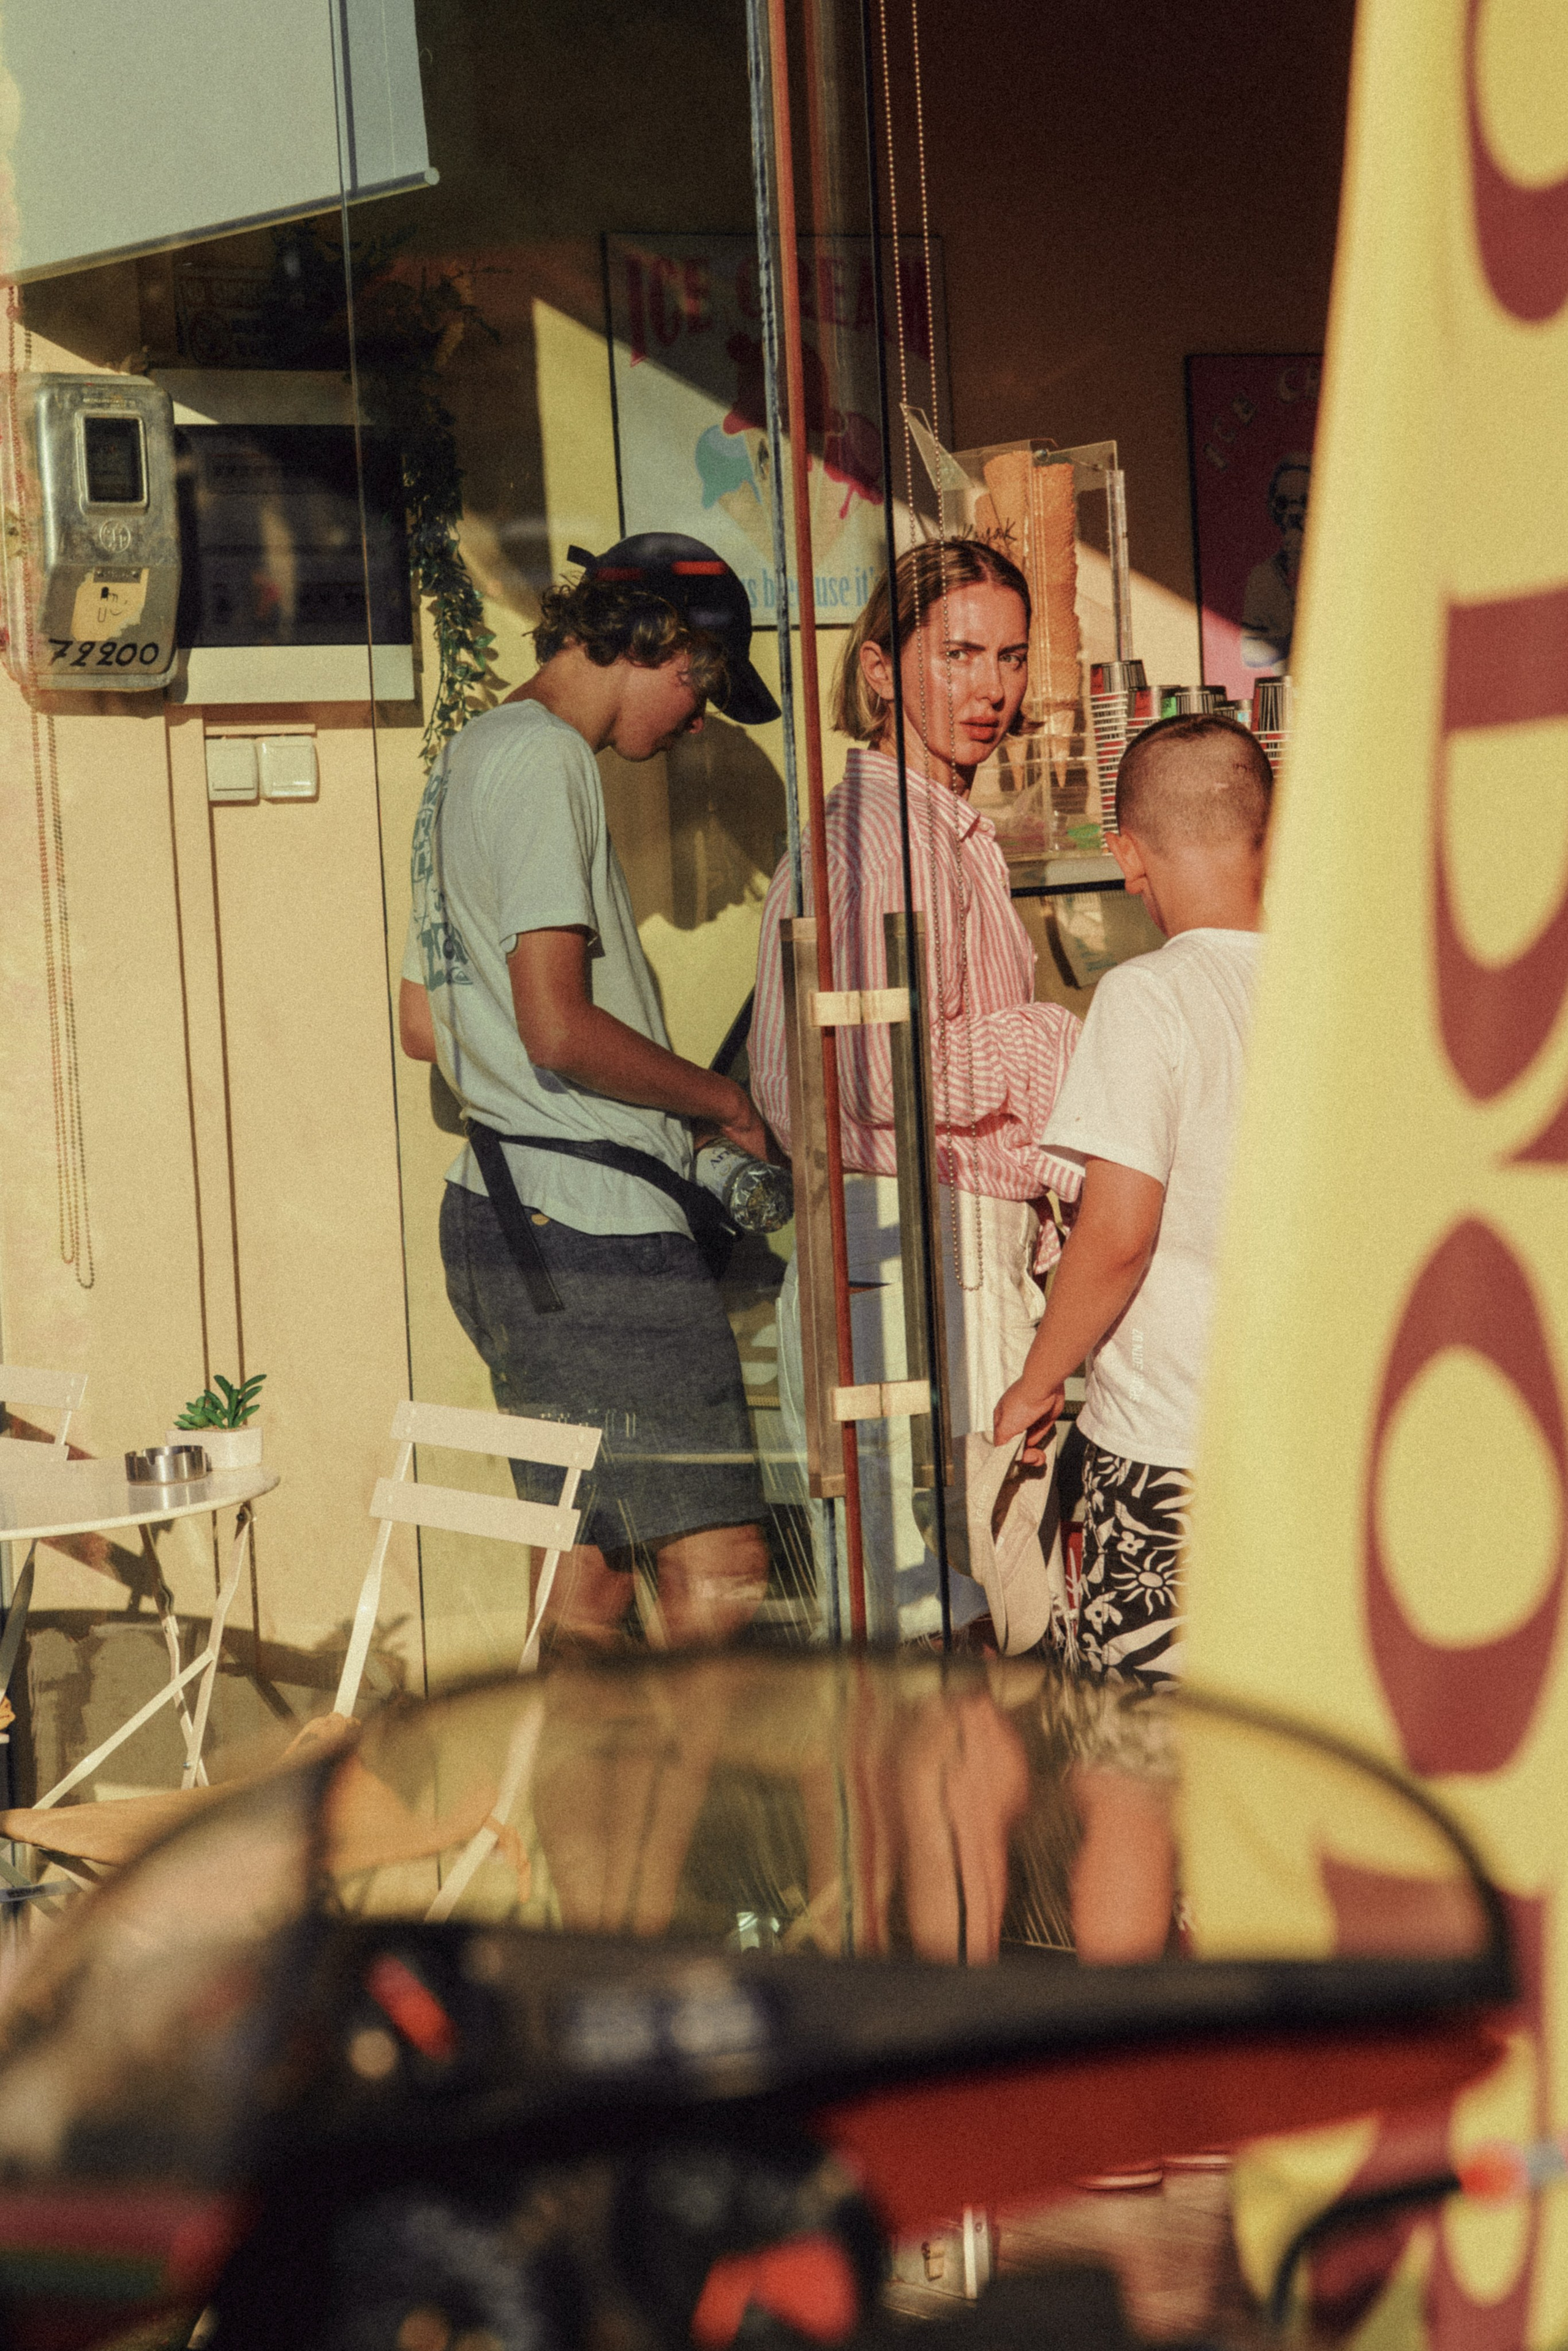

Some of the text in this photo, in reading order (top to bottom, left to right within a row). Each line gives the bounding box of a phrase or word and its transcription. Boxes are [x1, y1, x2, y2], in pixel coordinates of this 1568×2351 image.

[625, 257, 714, 368] ICE
[1202, 391, 1258, 473] ICE
[48, 639, 159, 666] 72200
